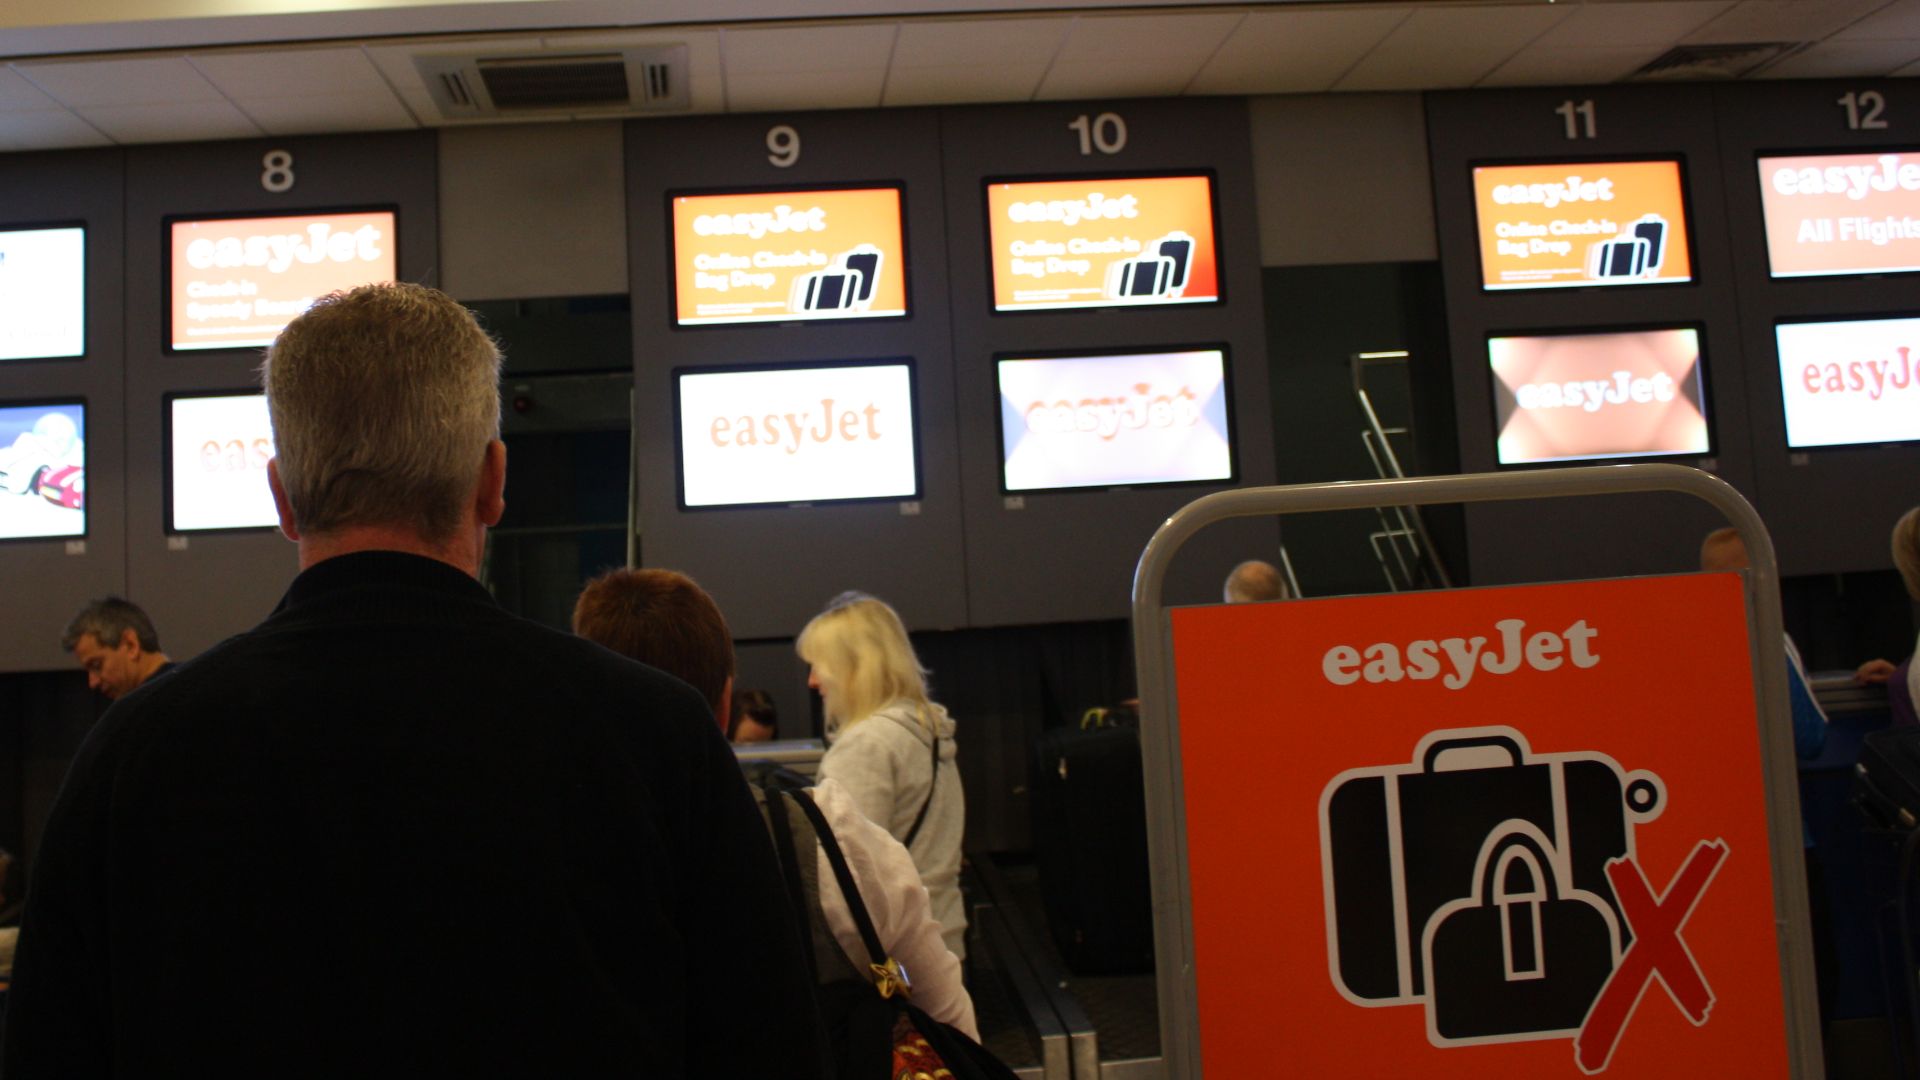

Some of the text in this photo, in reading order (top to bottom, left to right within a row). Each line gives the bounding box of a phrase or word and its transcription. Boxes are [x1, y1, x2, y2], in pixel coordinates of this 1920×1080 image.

[1555, 100, 1597, 139] 11
[1837, 91, 1888, 129] 12
[766, 125, 800, 167] 9
[1068, 112, 1127, 154] 10
[261, 150, 294, 192] 8
[1492, 176, 1614, 208] easyJet
[1772, 155, 1920, 200] easyJe
[693, 204, 826, 239] easyJet
[1008, 192, 1138, 226] easyJet
[186, 223, 382, 273] easyJet
[1797, 218, 1832, 243] All
[1516, 370, 1674, 412] easyJet
[1802, 346, 1920, 400] easyJ
[710, 398, 881, 454] easyJet
[1026, 382, 1198, 442] easyJet
[1322, 618, 1600, 690] easyJet
